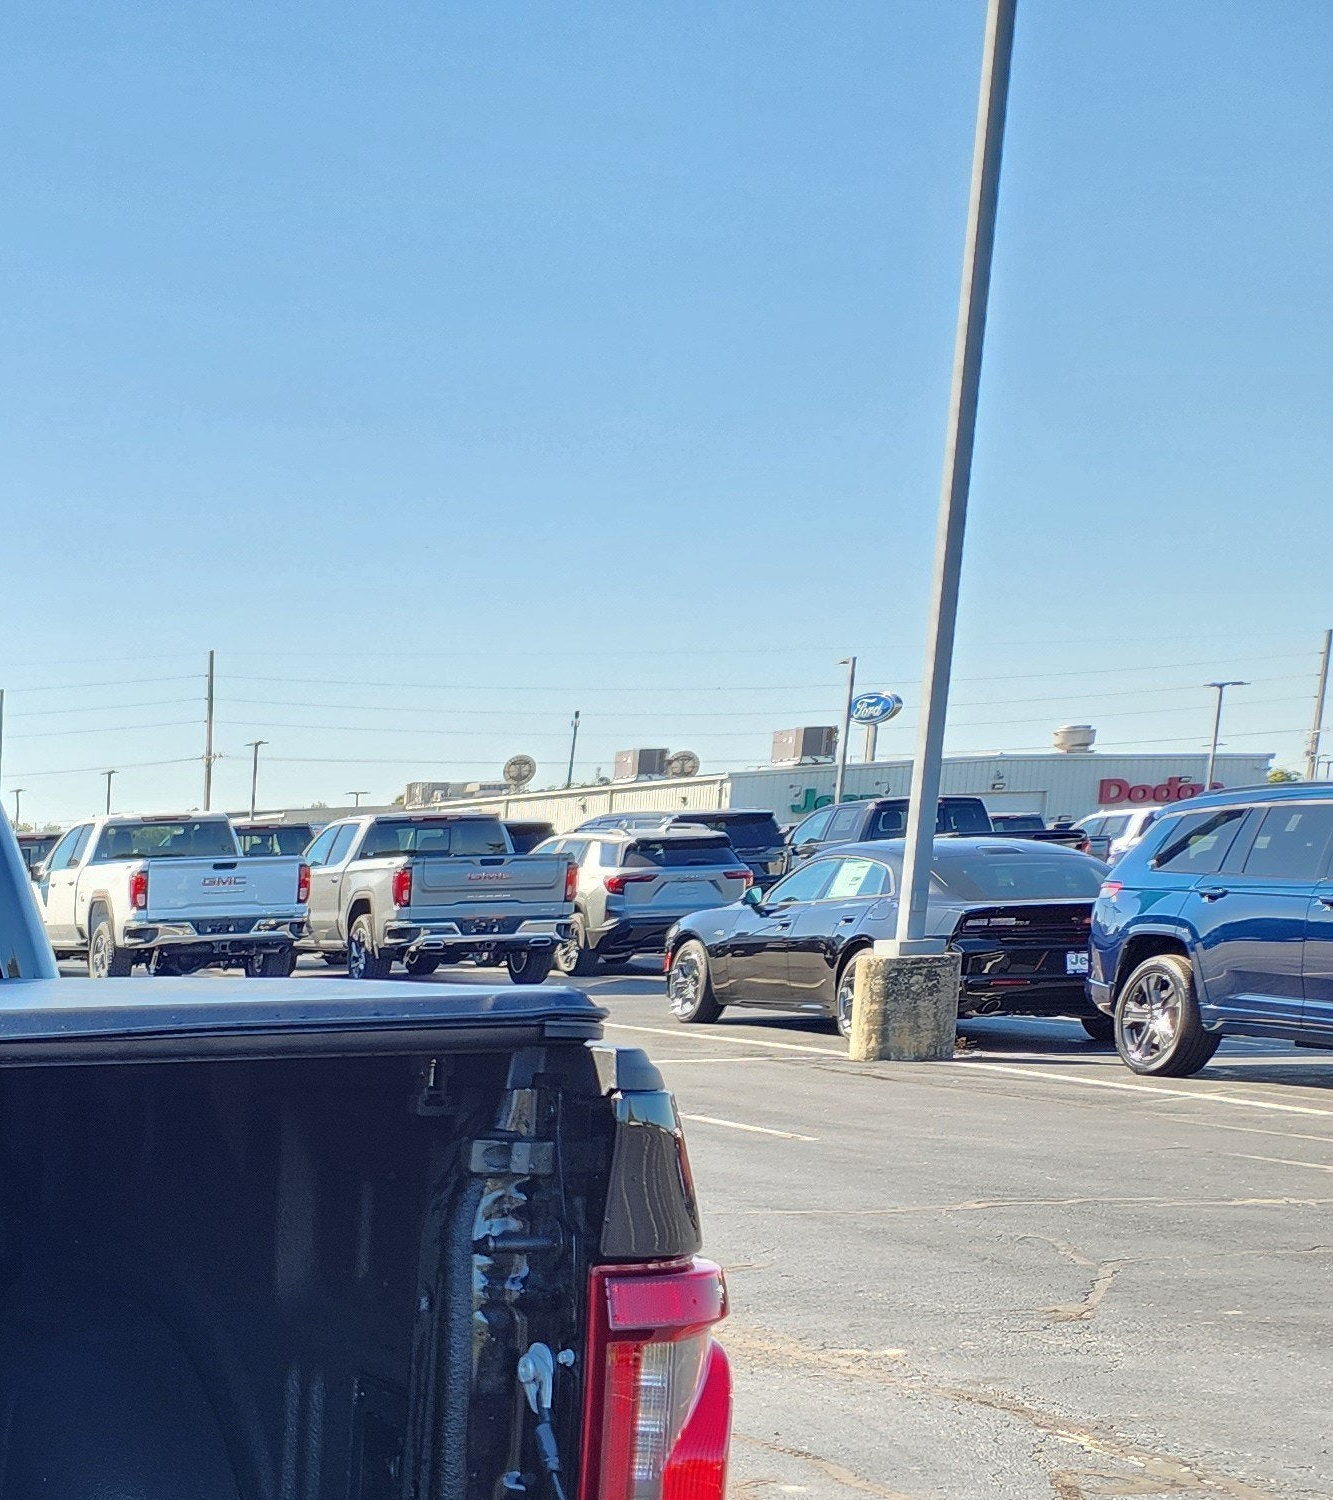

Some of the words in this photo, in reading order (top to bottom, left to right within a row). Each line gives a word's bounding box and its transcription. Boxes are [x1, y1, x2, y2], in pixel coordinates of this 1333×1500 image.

[853, 698, 885, 719] Ford
[1097, 776, 1225, 804] Dodg
[202, 876, 247, 886] GMC
[1070, 954, 1088, 966] Je
